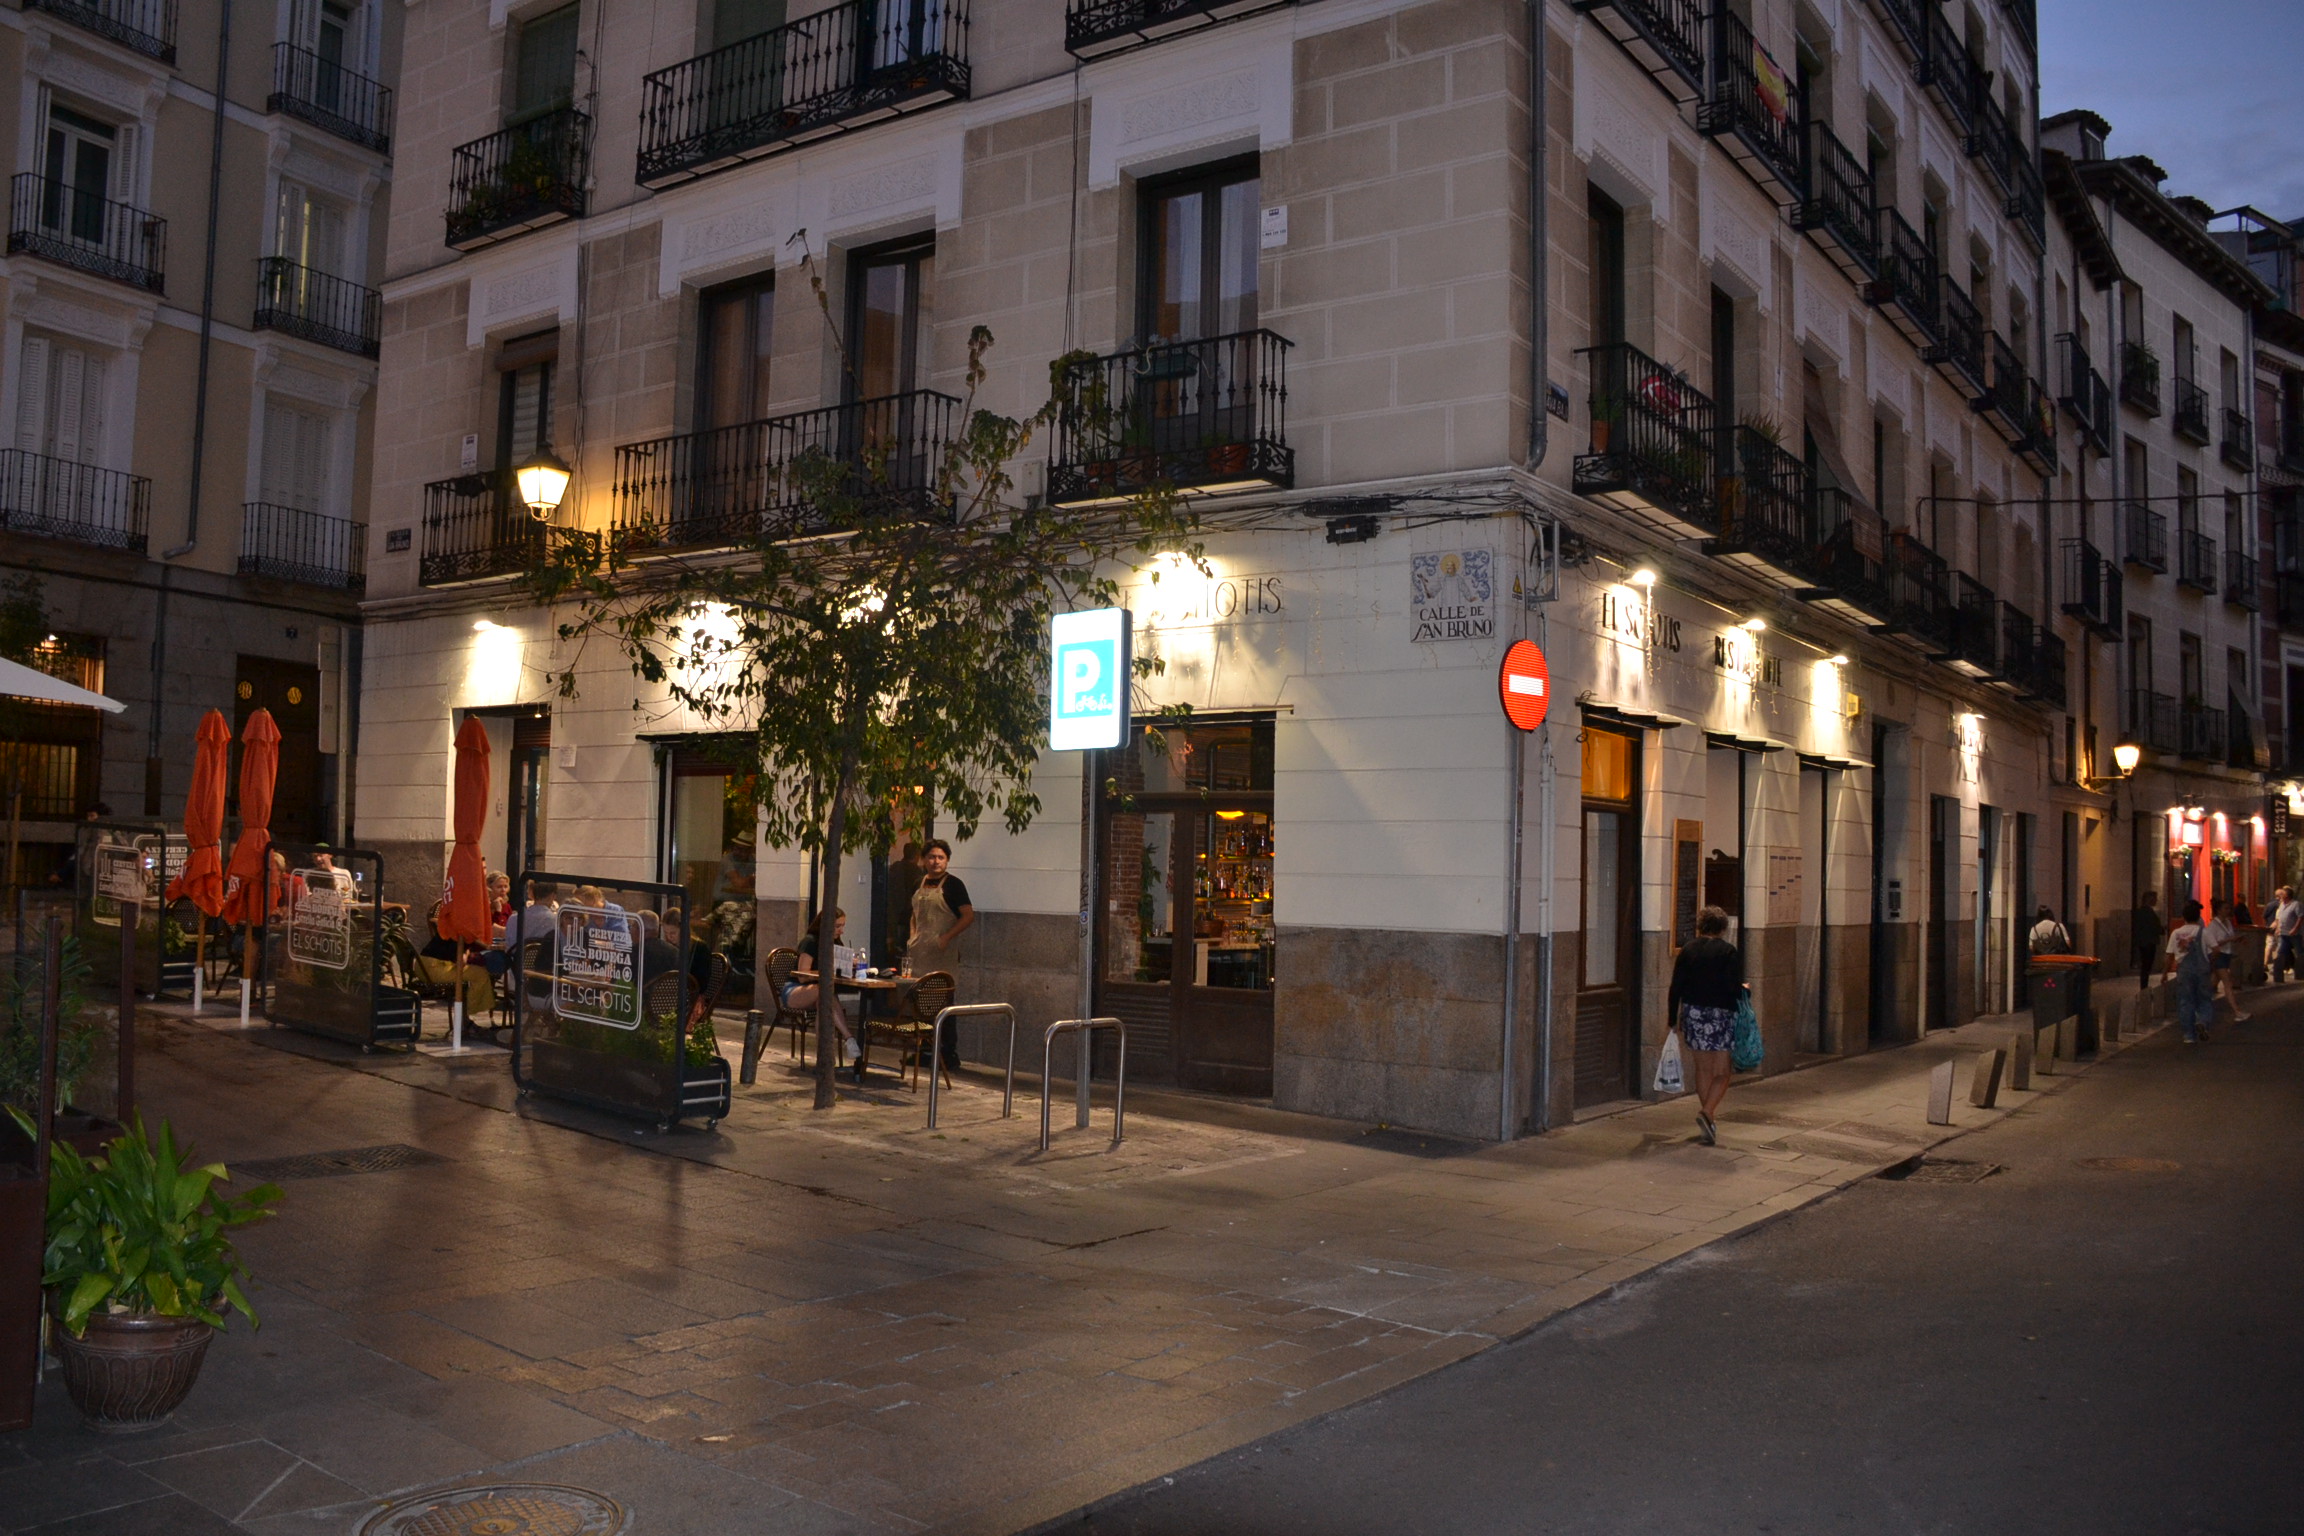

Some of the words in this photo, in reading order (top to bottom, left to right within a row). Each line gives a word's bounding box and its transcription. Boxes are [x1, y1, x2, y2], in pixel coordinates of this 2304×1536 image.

[1420, 606, 1466, 621] CALLE
[1470, 606, 1484, 616] DE
[1411, 622, 1442, 641] SAN
[1447, 619, 1492, 638] BRUNO
[1063, 649, 1101, 713] P
[2274, 799, 2286, 814] 17
[293, 932, 302, 948] EL
[304, 936, 342, 955] SCHOTIS
[588, 927, 633, 945] CERVEZA
[587, 947, 632, 966] BODEGA
[563, 957, 592, 973] Estrella
[592, 962, 621, 980] Galicia
[561, 983, 575, 1002] EL
[577, 986, 632, 1013] SCHOTIS
